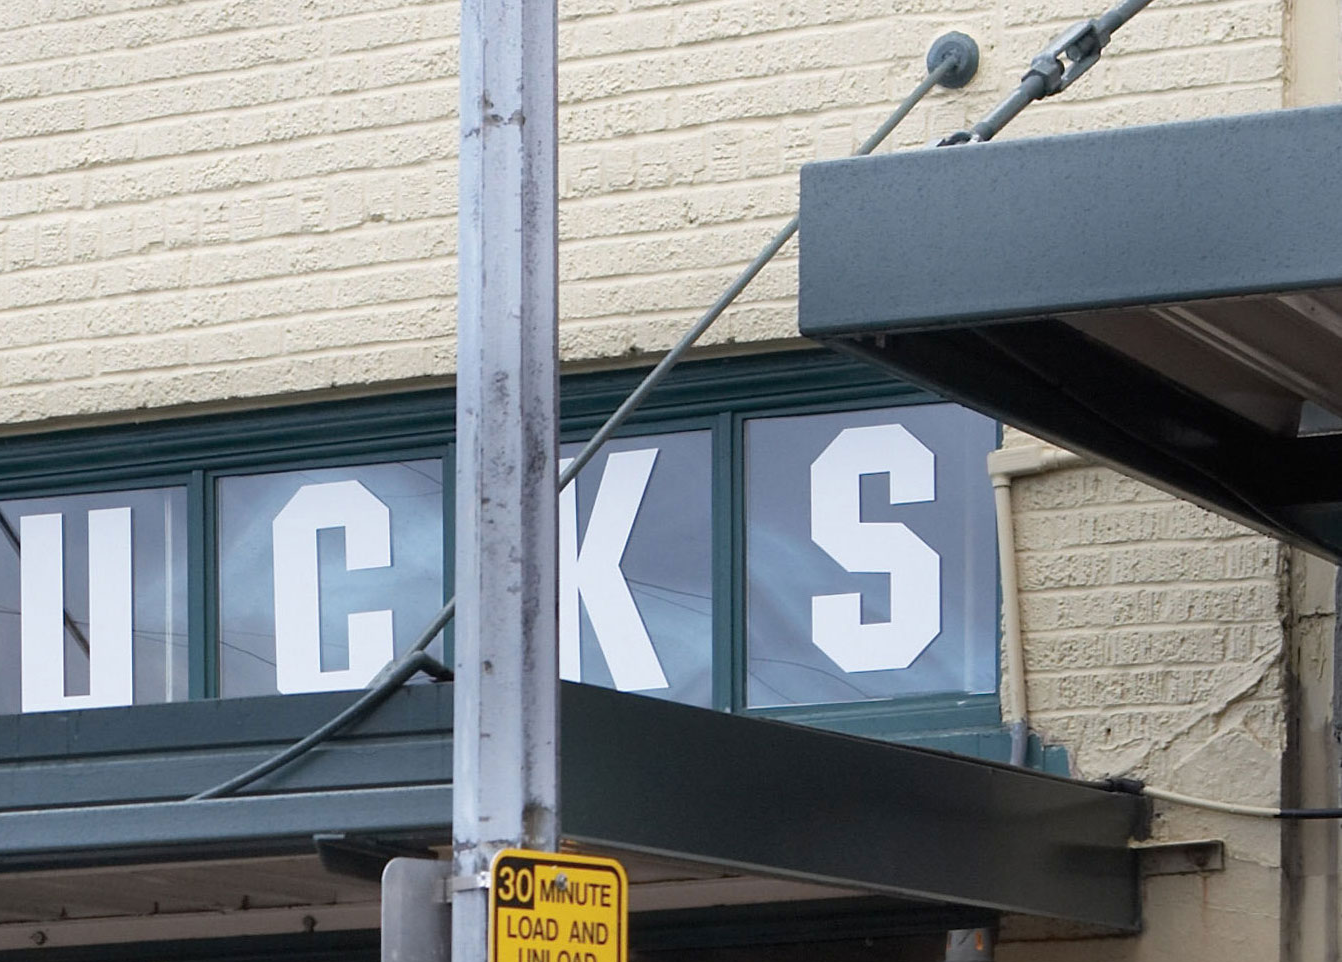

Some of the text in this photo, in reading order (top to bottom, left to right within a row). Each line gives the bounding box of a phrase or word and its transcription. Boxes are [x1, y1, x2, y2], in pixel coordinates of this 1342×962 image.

[498, 866, 611, 908] 30 MINUTE
[507, 915, 609, 945] LOAD AND
